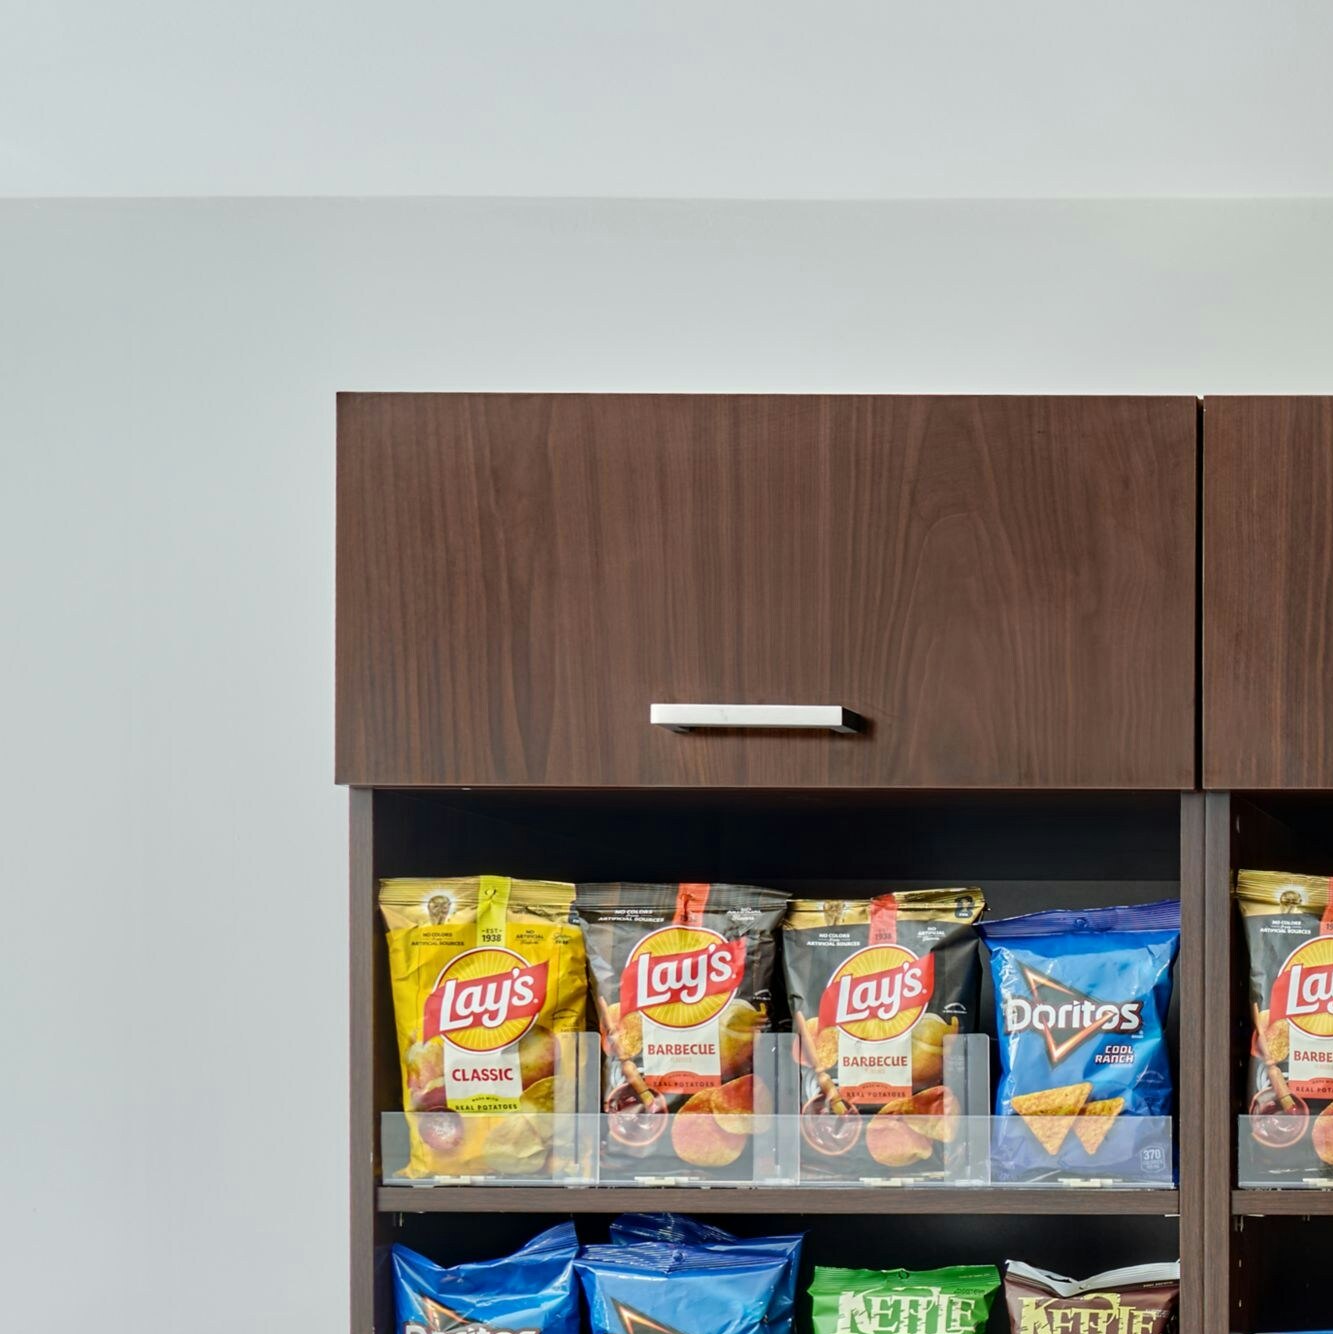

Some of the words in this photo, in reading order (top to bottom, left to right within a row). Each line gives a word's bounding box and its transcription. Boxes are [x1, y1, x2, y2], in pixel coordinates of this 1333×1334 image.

[638, 944, 736, 1007] Lay's
[439, 967, 538, 1031] Lay's
[1007, 999, 1142, 1030] Doritos
[648, 1043, 715, 1055] BARBECUE
[1105, 1045, 1134, 1054] COOL
[1095, 1054, 1134, 1064] RANCH
[452, 1068, 513, 1082] CLASSIC
[477, 1103, 517, 1111] POTATOES
